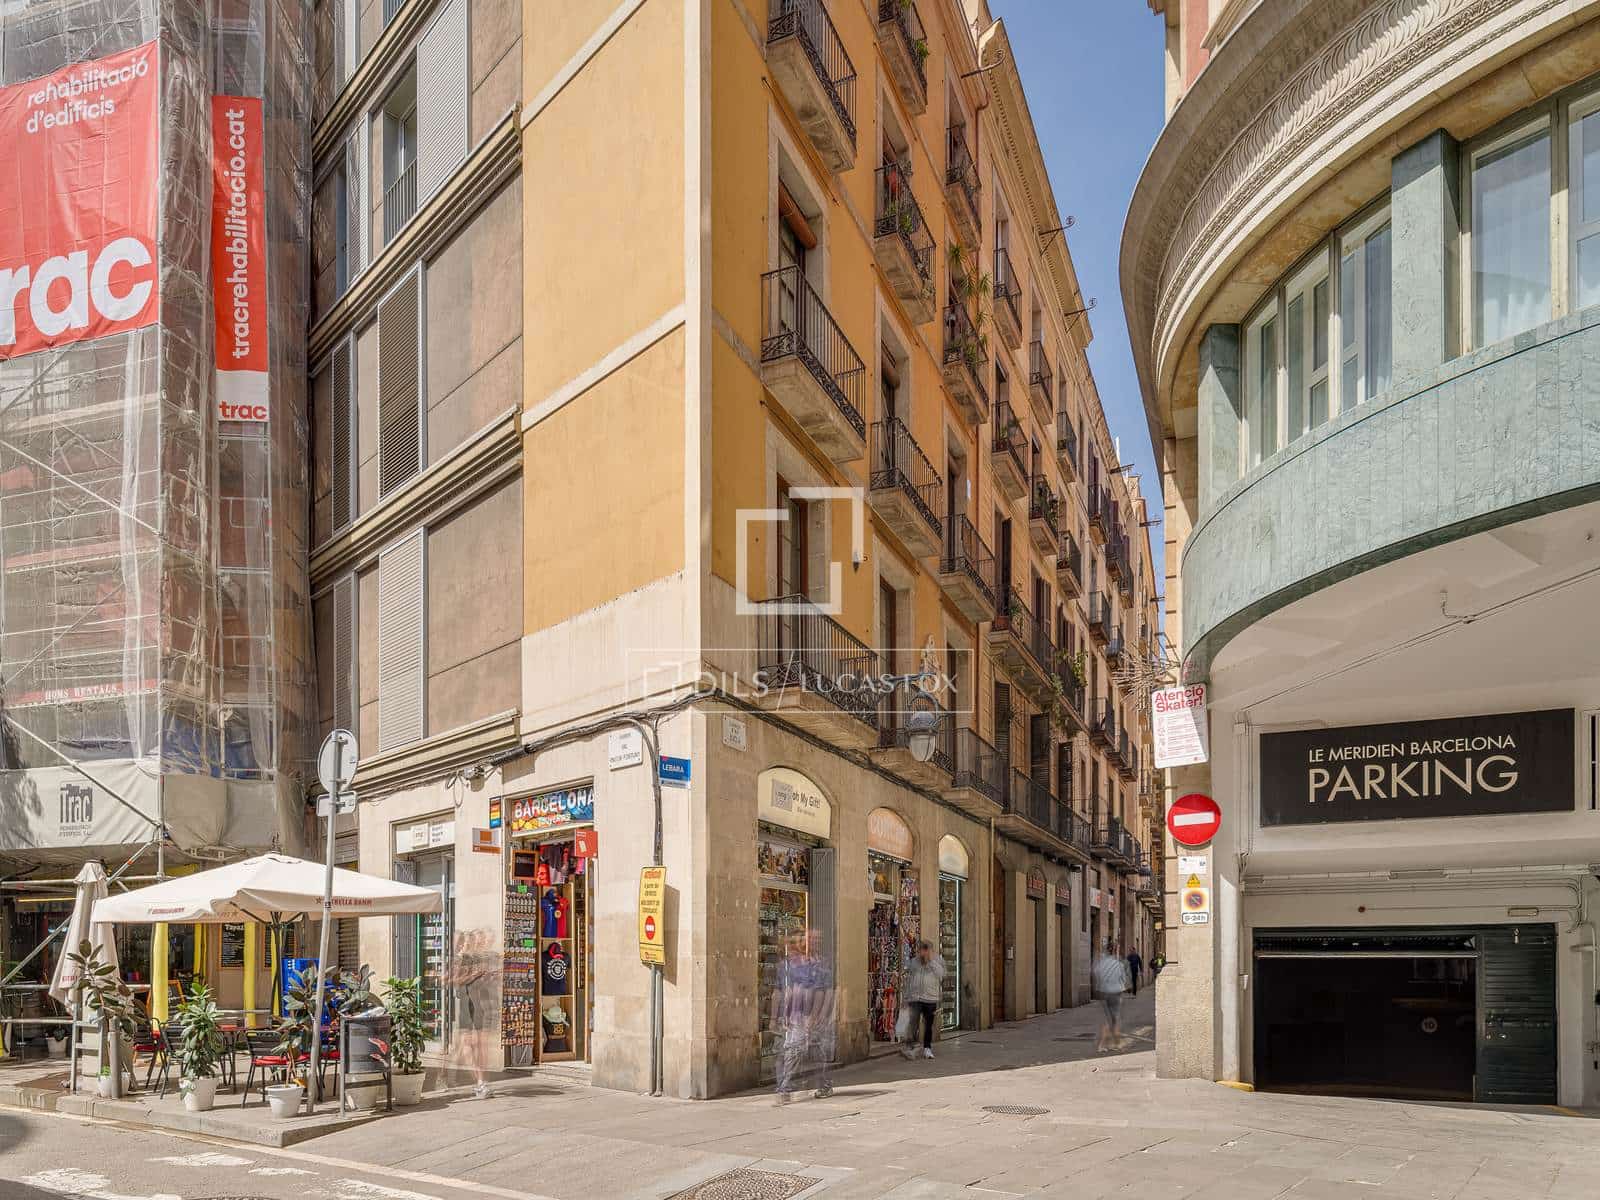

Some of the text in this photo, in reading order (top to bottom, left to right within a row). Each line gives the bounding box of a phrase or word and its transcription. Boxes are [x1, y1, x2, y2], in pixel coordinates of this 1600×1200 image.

[26, 57, 148, 108] rehabilitació
[26, 96, 115, 134] d'edificis
[223, 109, 250, 359] tracrehabilitacio.cat
[218, 401, 267, 420] trac
[1155, 685, 1204, 701] Atenció
[1156, 696, 1203, 713] Skater!
[1309, 734, 1516, 763] LE MERIDIEN BARCELONA
[662, 763, 685, 774] LEBARA
[1308, 754, 1519, 803] PARKING
